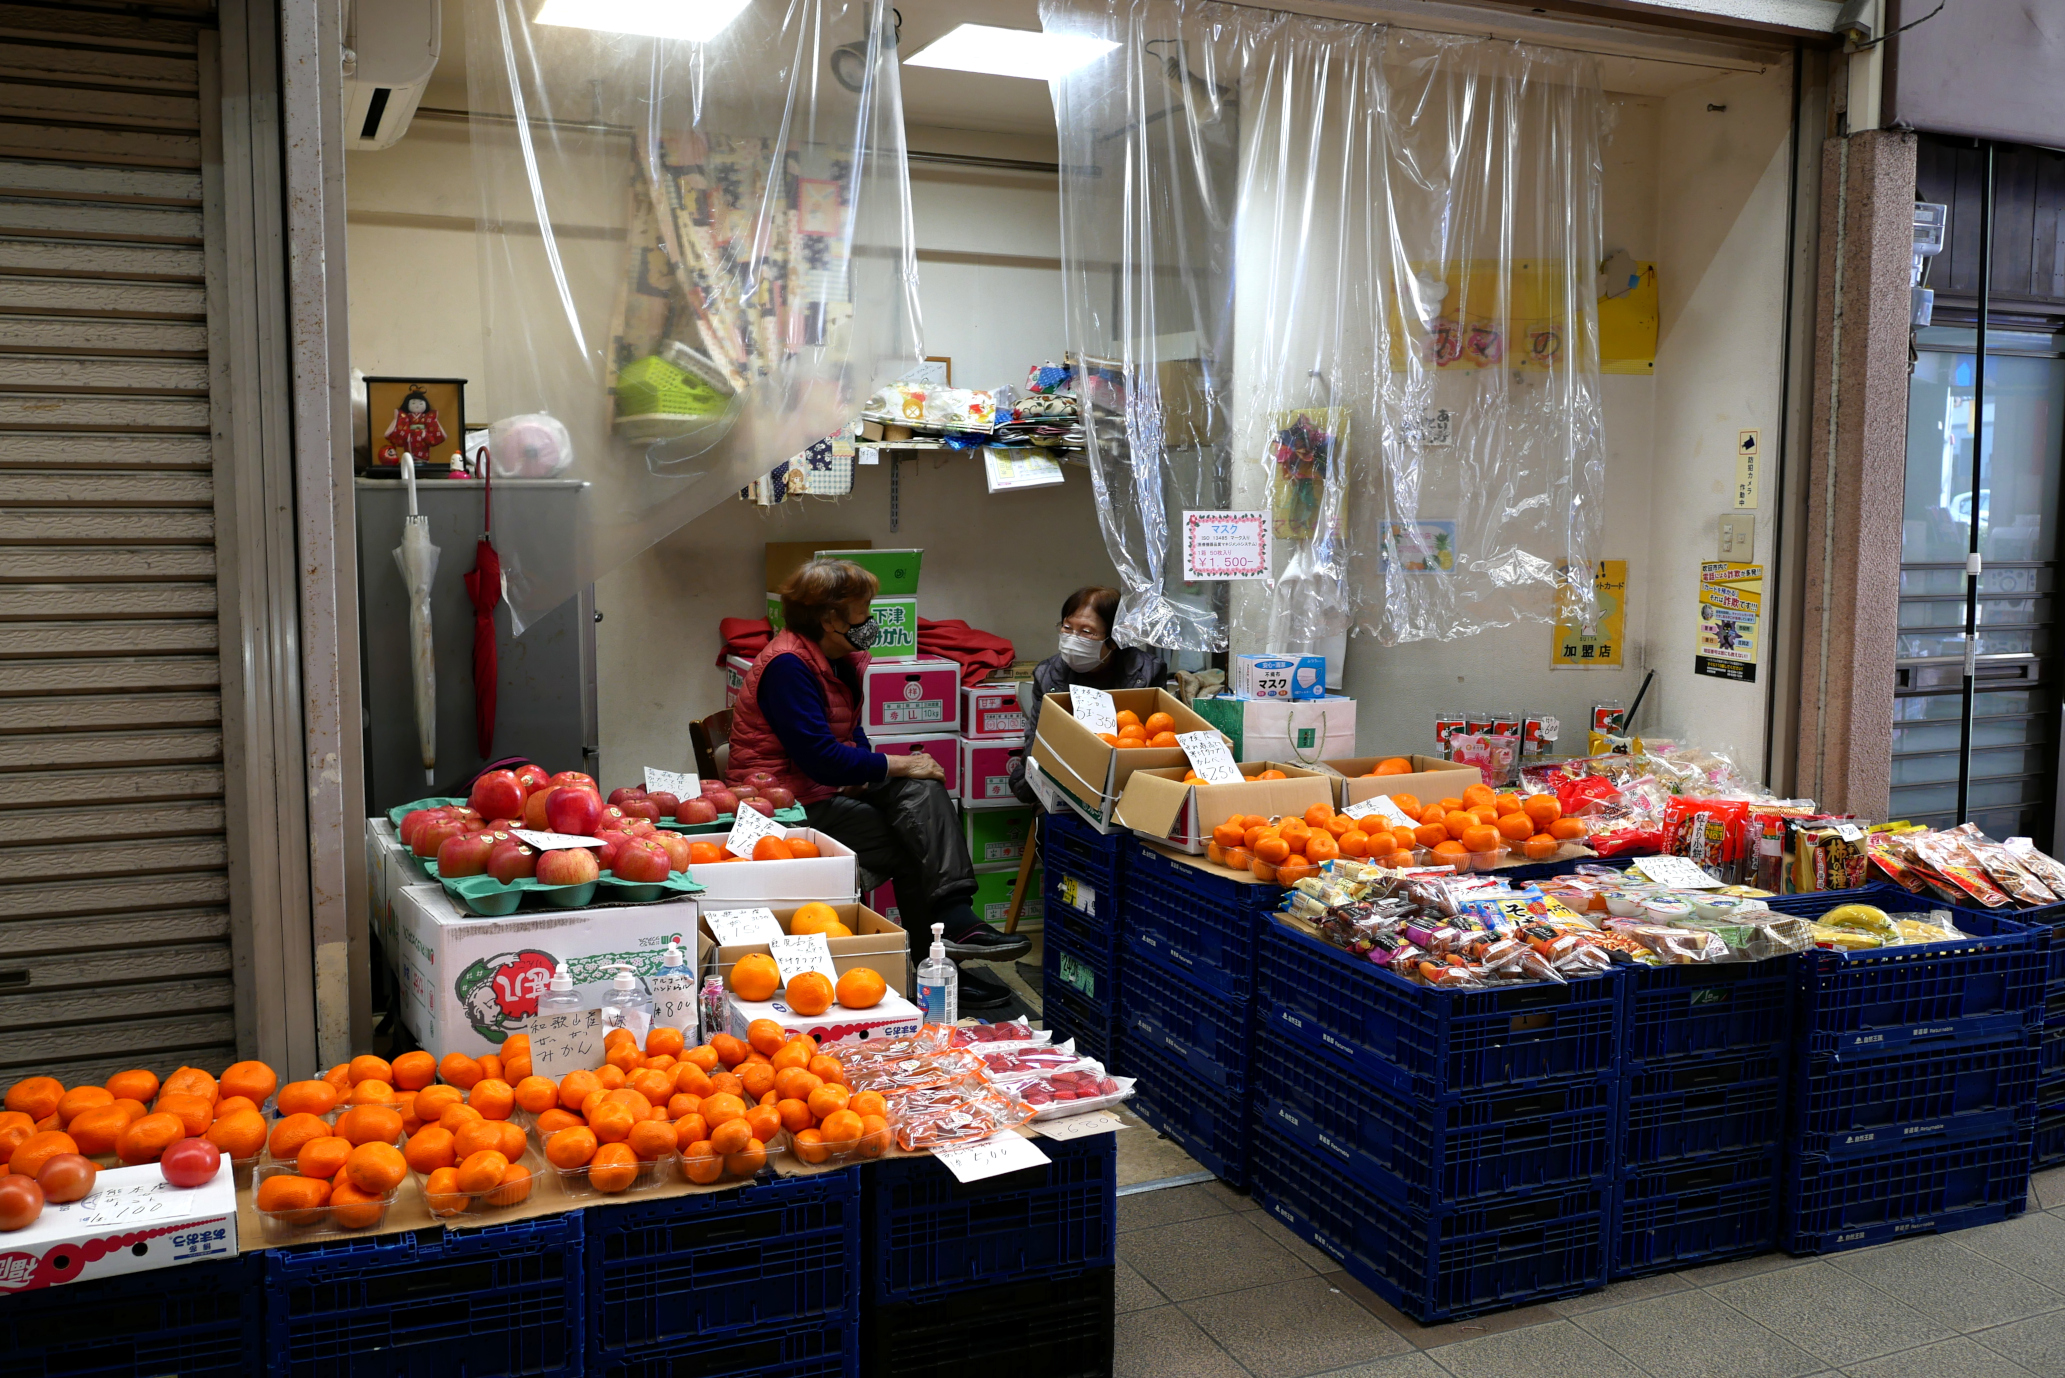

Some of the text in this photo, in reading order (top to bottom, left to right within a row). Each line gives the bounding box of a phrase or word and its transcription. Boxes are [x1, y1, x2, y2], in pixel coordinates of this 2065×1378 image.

[1746, 456, 1754, 495] 防犯カメラ
[1738, 484, 1746, 507] 作動中
[1211, 524, 1238, 534] マスク
[872, 607, 906, 625] 下津
[1563, 644, 1611, 658] 加盟店
[1258, 680, 1287, 689] マスク
[1095, 714, 1116, 729] 350
[1209, 765, 1235, 782] 250
[1693, 813, 1706, 859] 粒より小餅
[1705, 829, 1723, 840] No.1
[1826, 839, 1848, 889] 柿の種
[667, 1000, 691, 1018] 800
[530, 1011, 600, 1034] 和歌山産
[885, 1024, 918, 1036] あまおう
[535, 1041, 593, 1062] みかん
[116, 1203, 163, 1218] 100
[173, 1228, 226, 1247] あまおう
